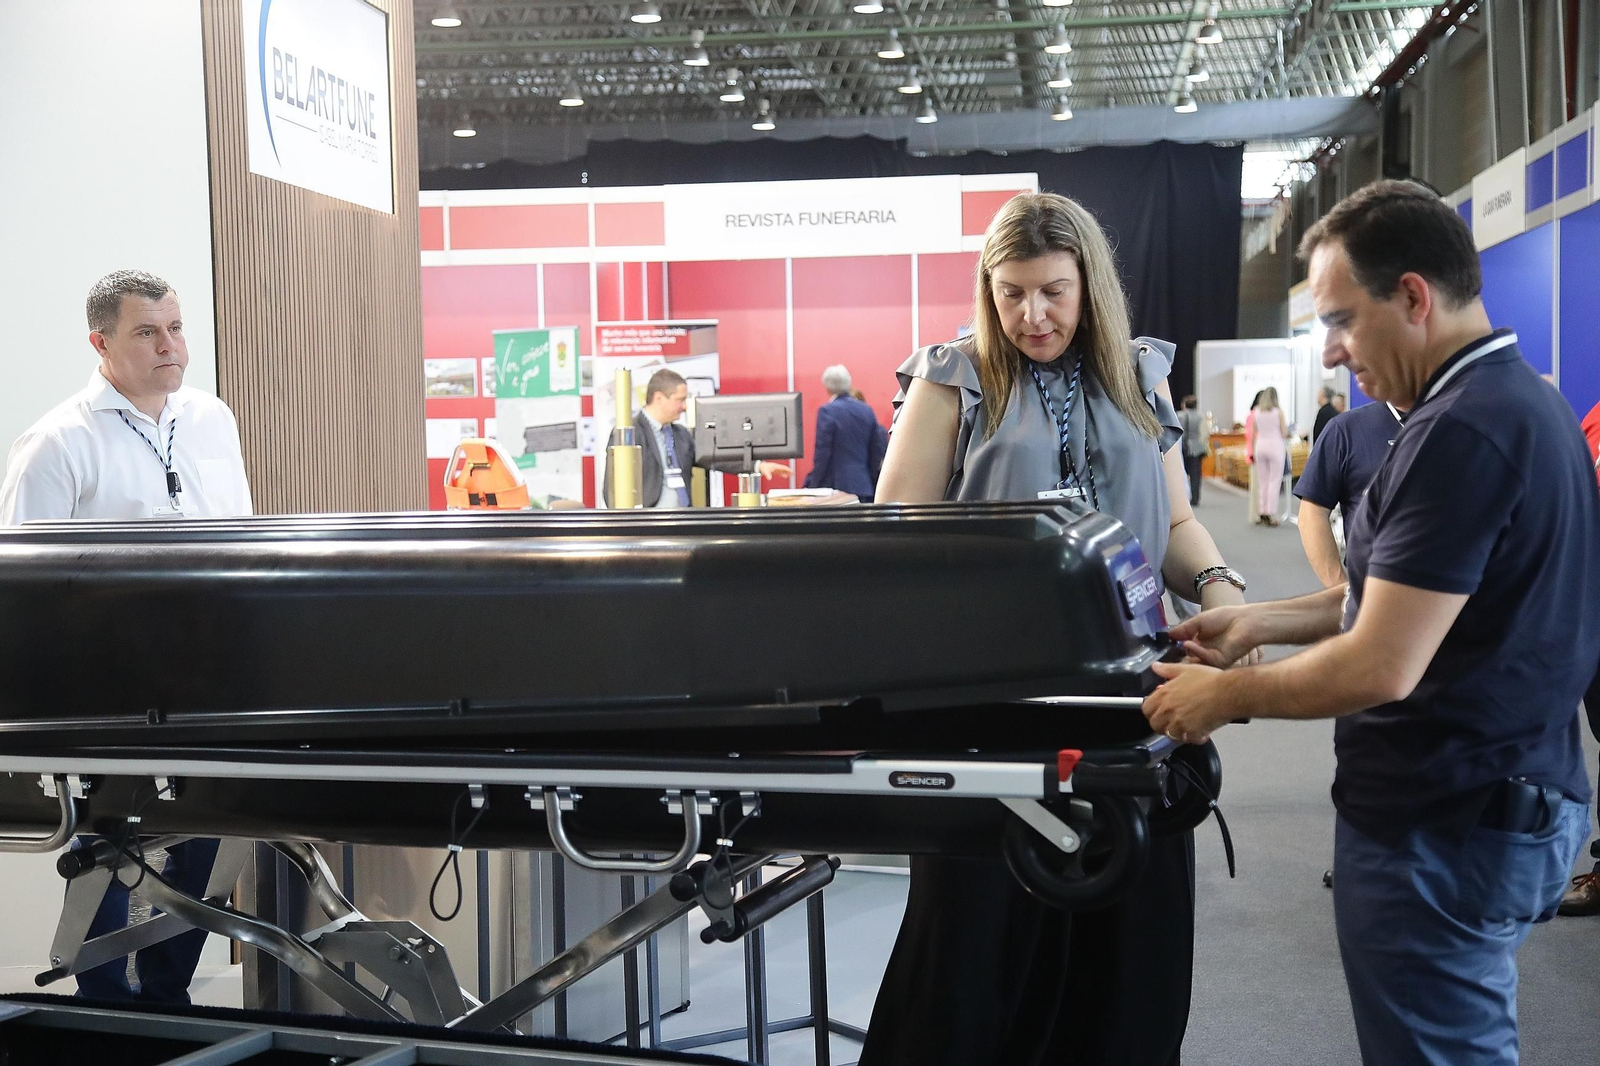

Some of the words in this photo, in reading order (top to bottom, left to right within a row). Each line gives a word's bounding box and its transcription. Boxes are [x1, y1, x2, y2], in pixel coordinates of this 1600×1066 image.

[272, 46, 377, 140] BELARTFUNE
[725, 213, 794, 228] REVISTA
[798, 210, 897, 225] FUNERARIA
[1126, 576, 1157, 608] SPENCER
[896, 775, 946, 786] SPENCER
